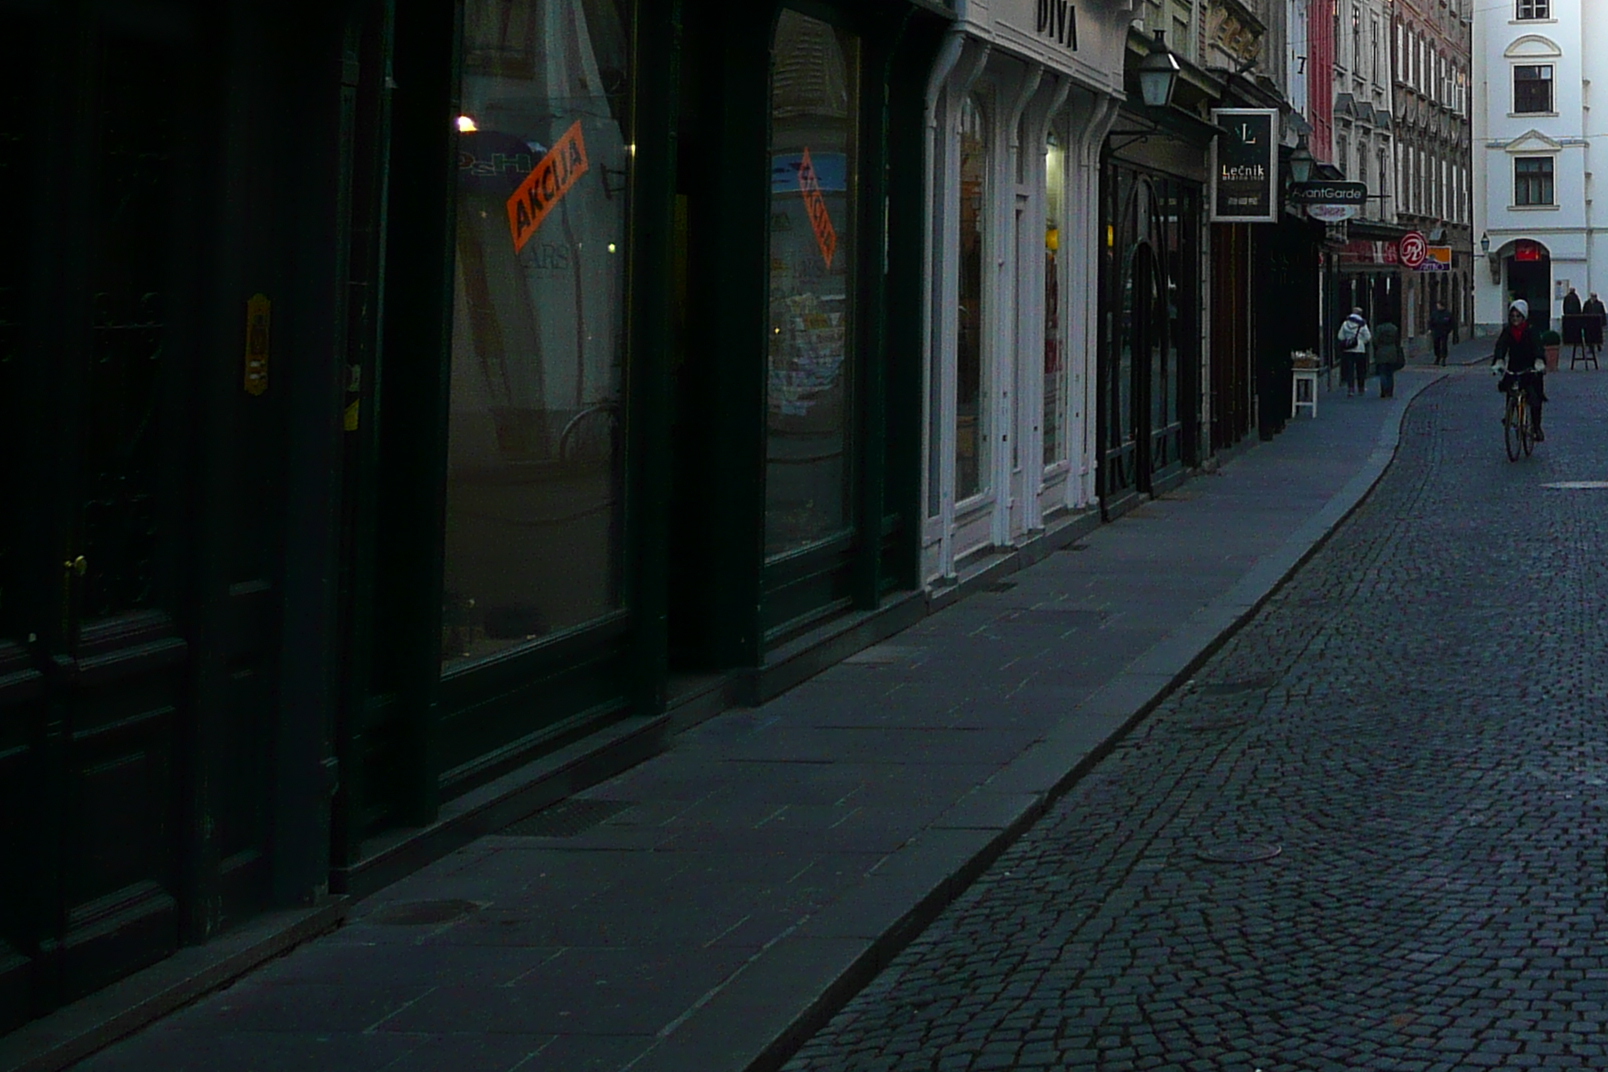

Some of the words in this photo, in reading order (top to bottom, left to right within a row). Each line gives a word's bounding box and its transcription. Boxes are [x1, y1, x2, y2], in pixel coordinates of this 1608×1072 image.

[1222, 164, 1265, 177] Lečnik
[516, 138, 582, 240] AKCIJA
[1292, 188, 1362, 199] AvantGarde
